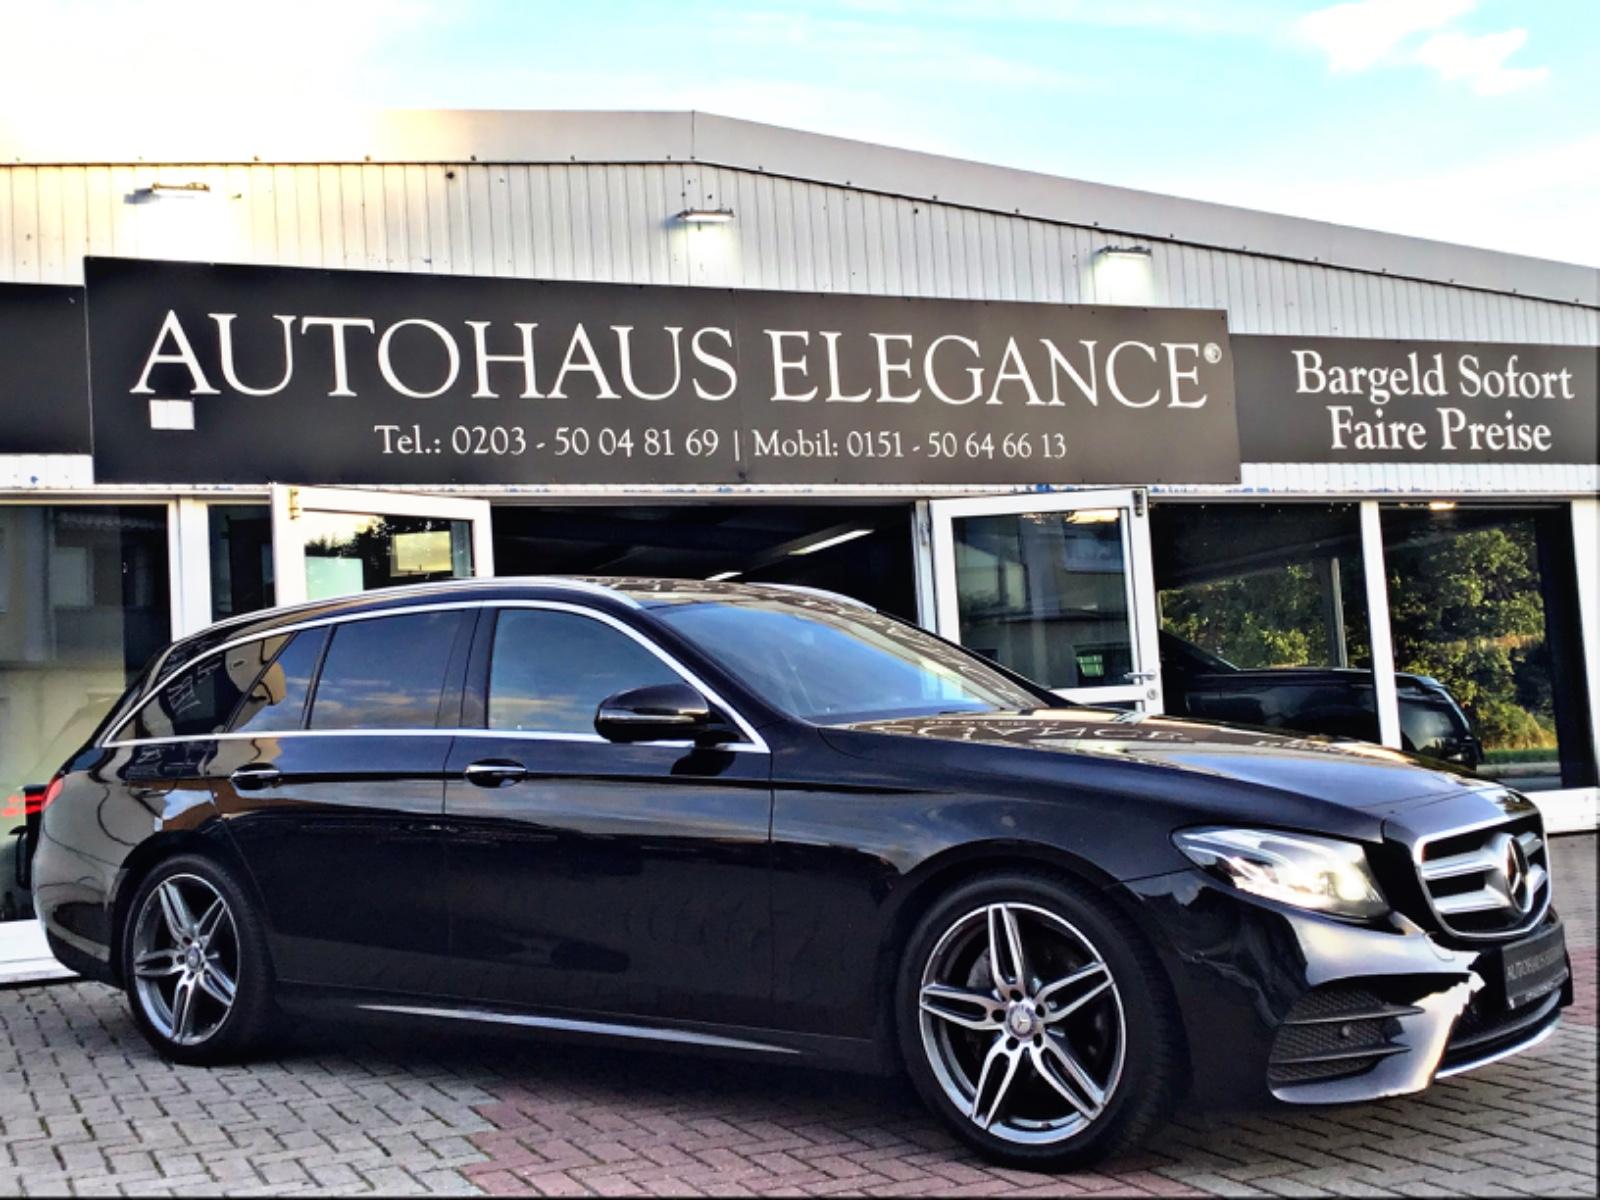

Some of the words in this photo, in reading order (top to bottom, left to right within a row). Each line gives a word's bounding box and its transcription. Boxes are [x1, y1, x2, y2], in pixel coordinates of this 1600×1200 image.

[130, 309, 739, 402] AUTOHAUS
[1291, 349, 1449, 405] Bargeld
[1457, 354, 1575, 400] Sofort
[373, 424, 441, 454] Tel.:
[451, 425, 527, 456] 0203
[554, 426, 590, 456] 50
[598, 427, 635, 458] 04
[644, 427, 676, 456] 81
[685, 428, 720, 457] 69
[751, 428, 839, 458] Mobil:
[846, 430, 905, 458] 0151
[927, 430, 958, 458] 50
[964, 431, 996, 460] 64
[1001, 431, 1033, 460] 66
[1040, 431, 1068, 460] 13
[1326, 405, 1427, 450] Faire
[1436, 407, 1552, 452] Preise
